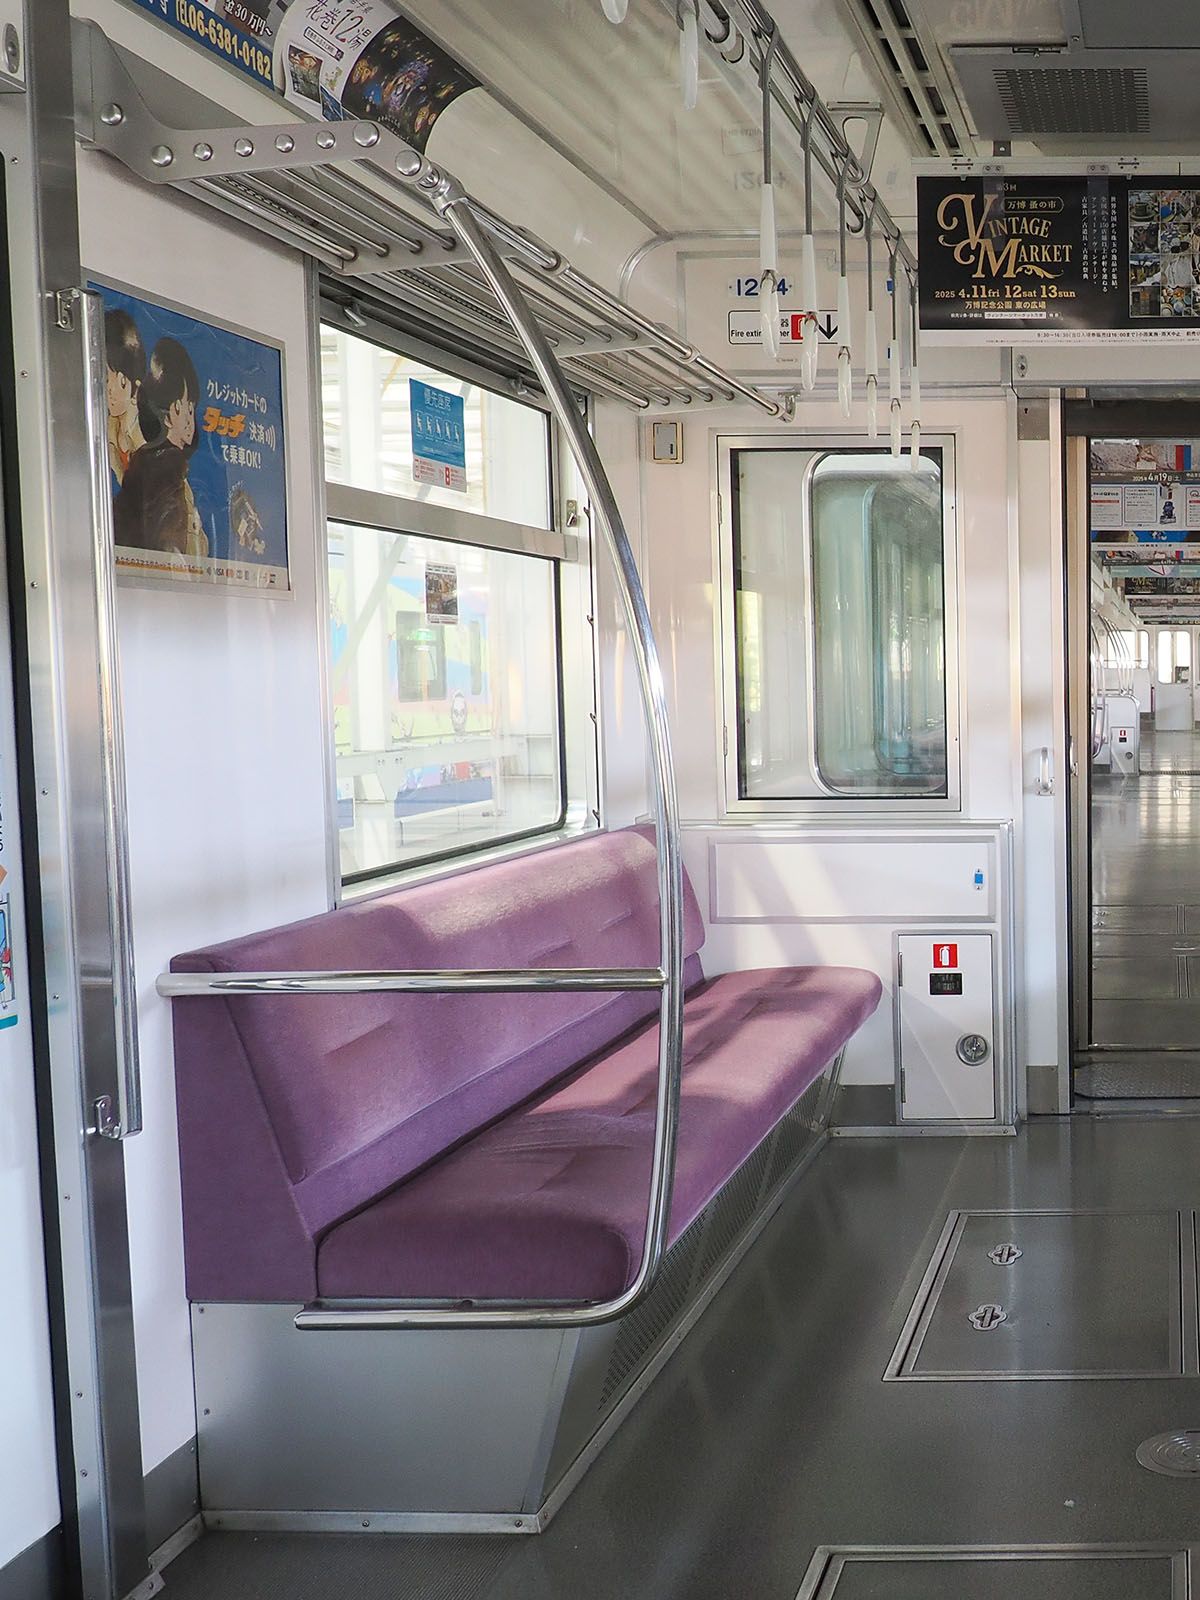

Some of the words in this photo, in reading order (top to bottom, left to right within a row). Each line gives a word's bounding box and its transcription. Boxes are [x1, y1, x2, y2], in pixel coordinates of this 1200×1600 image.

[175, 0, 272, 81] TEL06-6381-0182
[1007, 200, 1027, 210] 万博
[937, 194, 1052, 250] VINTAGE
[953, 238, 1072, 278] MARKET
[737, 278, 789, 296] 124
[935, 290, 956, 298] 2025
[958, 285, 1000, 298] 4.11fri
[1004, 285, 1038, 298] 12sat
[1040, 285, 1076, 298] 13sun
[964, 301, 1013, 310] 万博記念公園
[1015, 301, 1047, 309] 東の広場
[731, 329, 745, 337] Fire
[206, 379, 267, 414] クレジットカードの
[202, 406, 247, 439] タッチ
[249, 420, 265, 444] 決済
[221, 444, 262, 469] で乗車OK!
